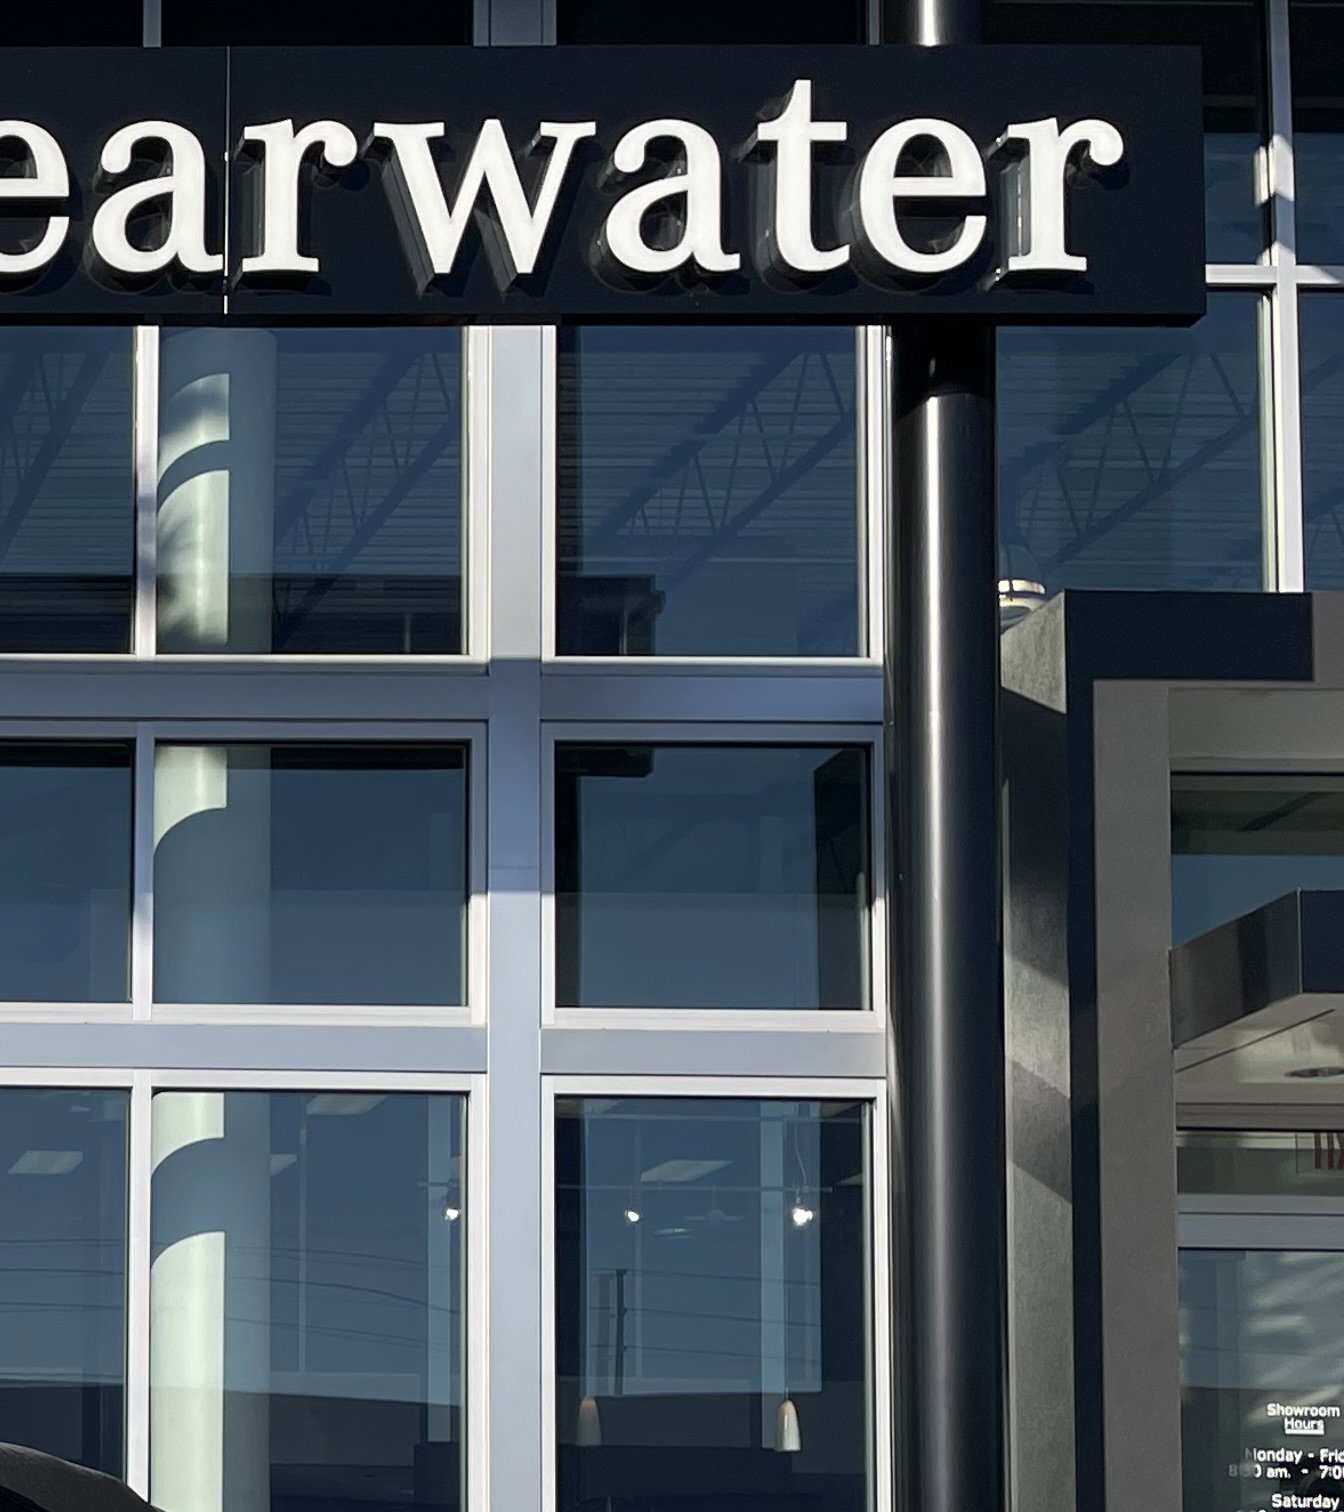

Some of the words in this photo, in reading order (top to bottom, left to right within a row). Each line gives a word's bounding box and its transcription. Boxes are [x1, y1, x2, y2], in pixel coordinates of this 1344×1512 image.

[1267, 1403, 1340, 1418] Showroom
[1284, 1417, 1324, 1432] Hours
[1245, 1447, 1303, 1464] Monday
[1272, 1493, 1340, 1511] Saturday
